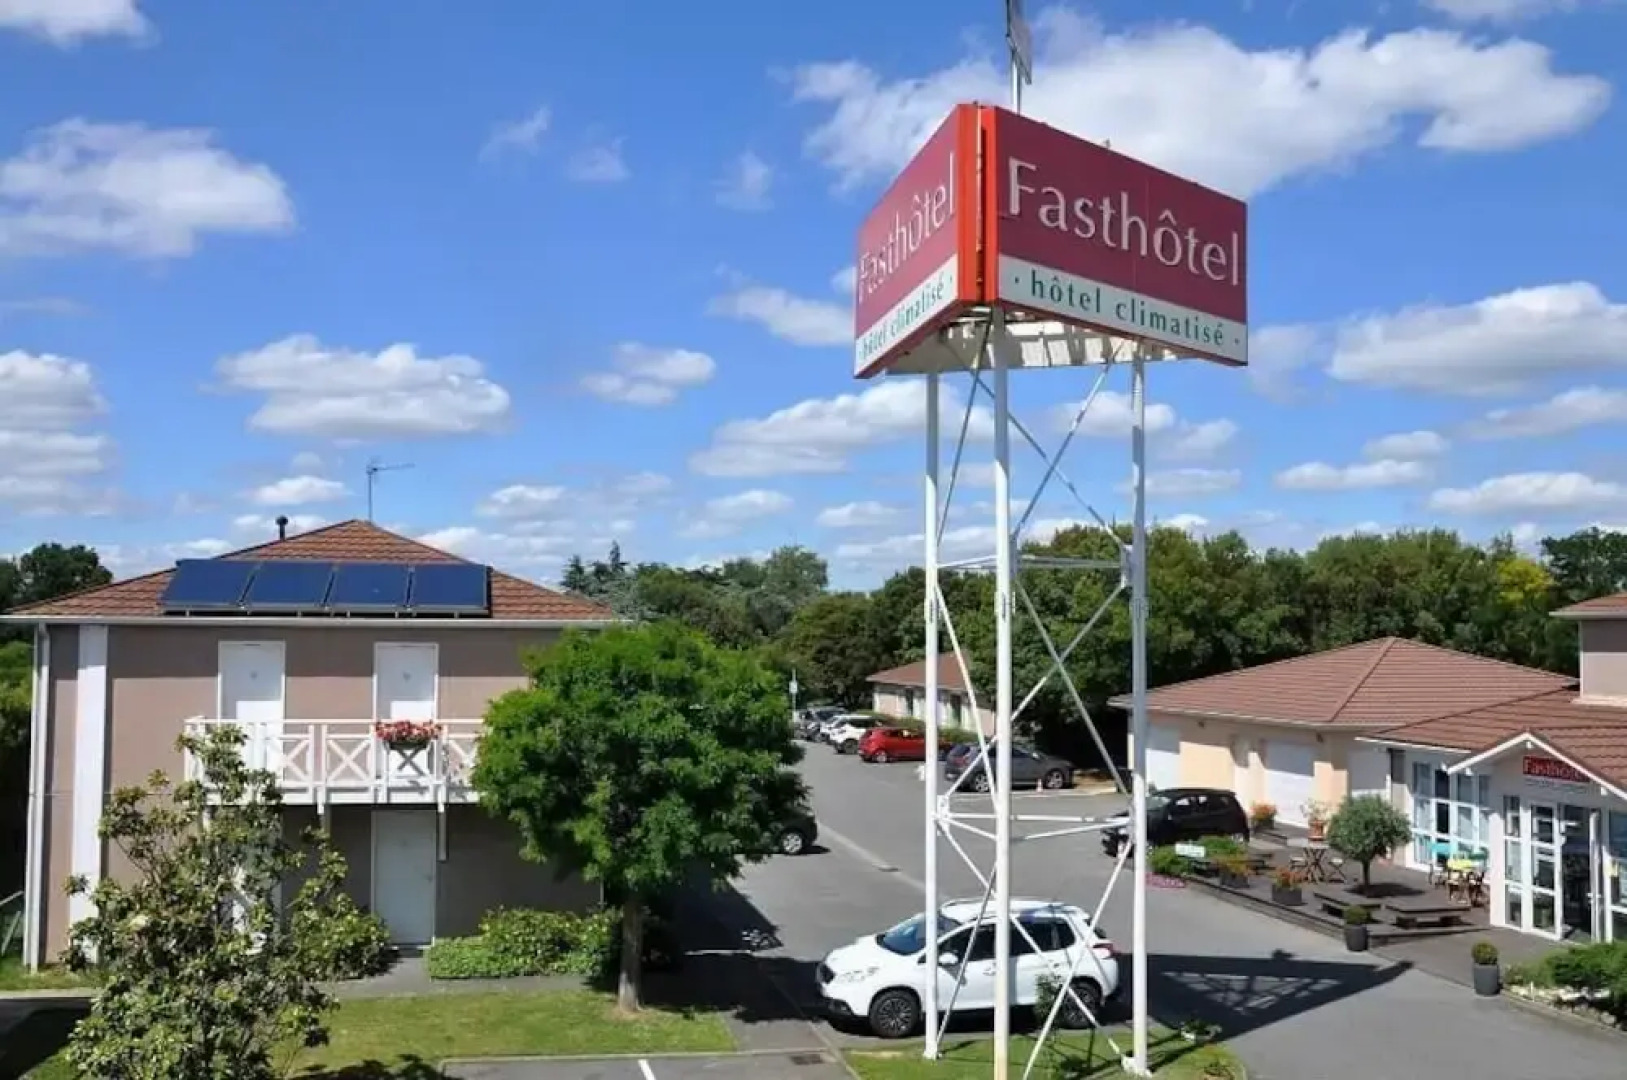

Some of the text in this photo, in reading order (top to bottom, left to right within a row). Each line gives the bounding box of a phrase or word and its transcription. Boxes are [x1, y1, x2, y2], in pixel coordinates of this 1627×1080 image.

[858, 151, 954, 304] Fasthôtel
[1008, 156, 1239, 286] Fasthôtel
[1031, 270, 1225, 346] hôtel climatisé
